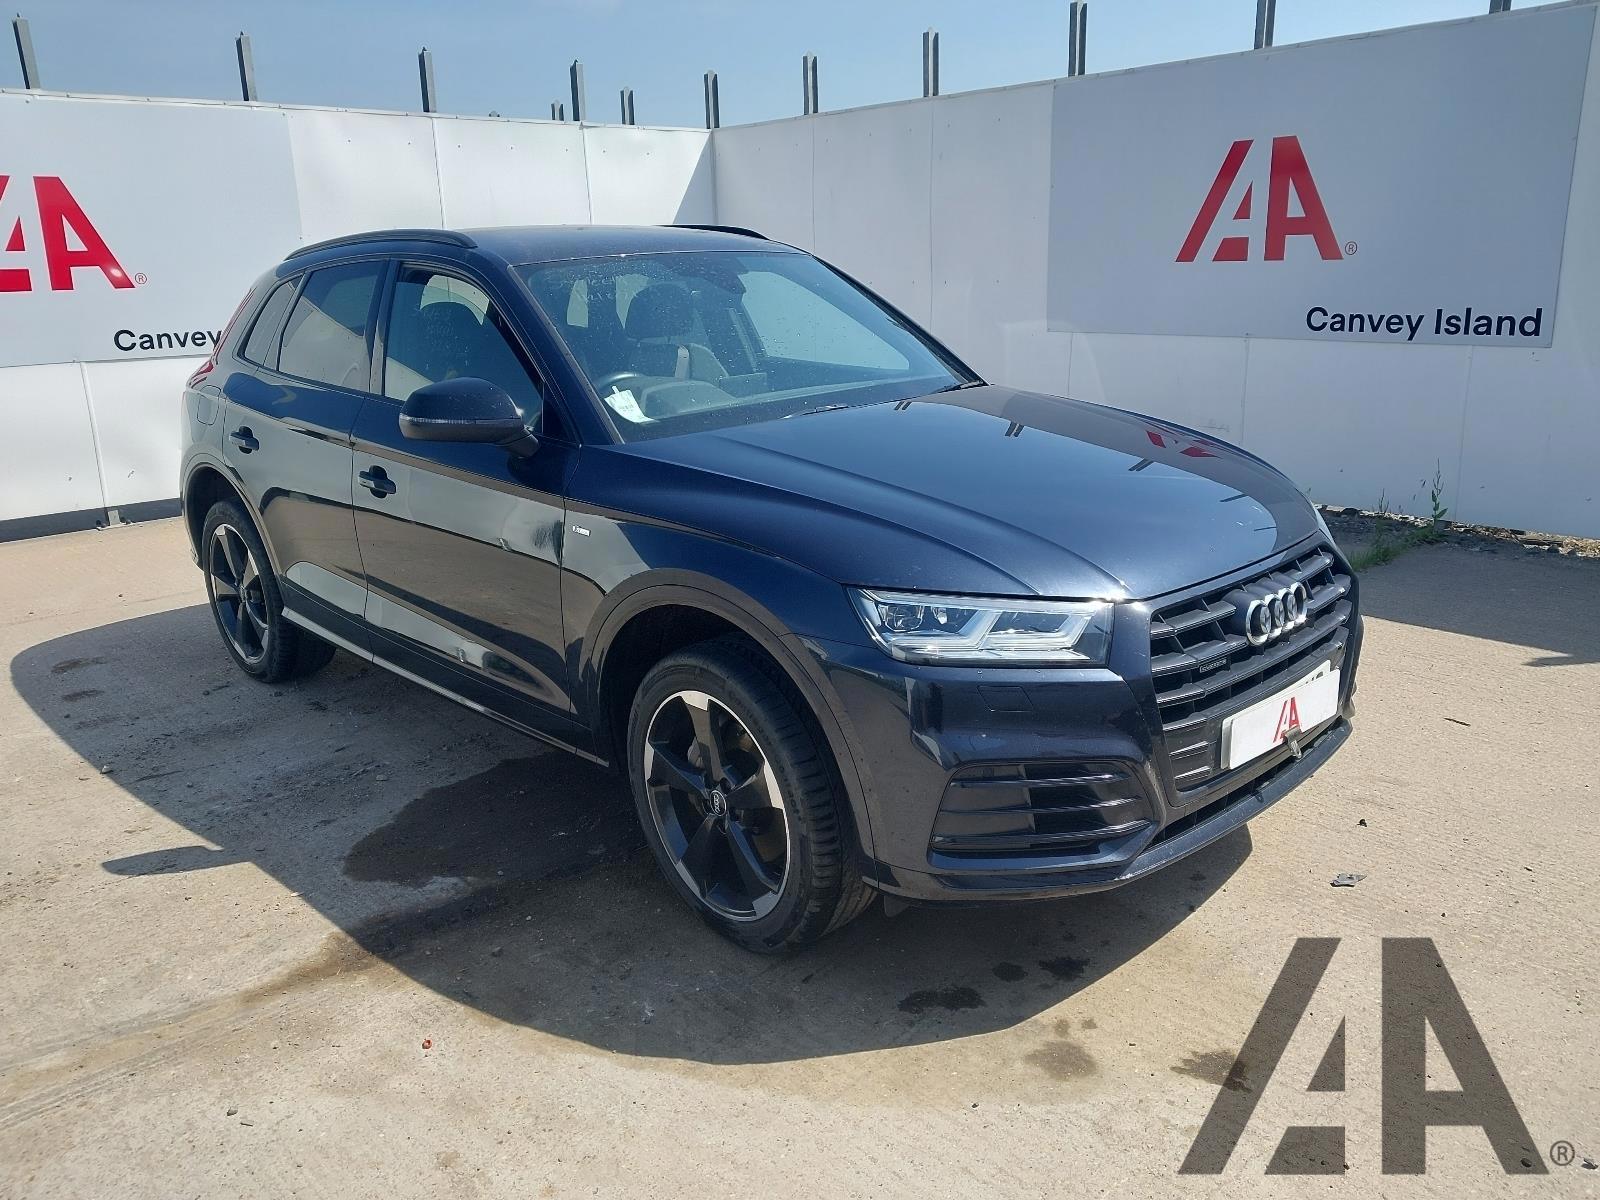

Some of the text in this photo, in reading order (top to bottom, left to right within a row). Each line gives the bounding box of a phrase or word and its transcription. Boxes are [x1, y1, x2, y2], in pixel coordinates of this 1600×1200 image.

[1306, 306, 1543, 341] Canvey Island
[113, 329, 222, 351] Canvey
